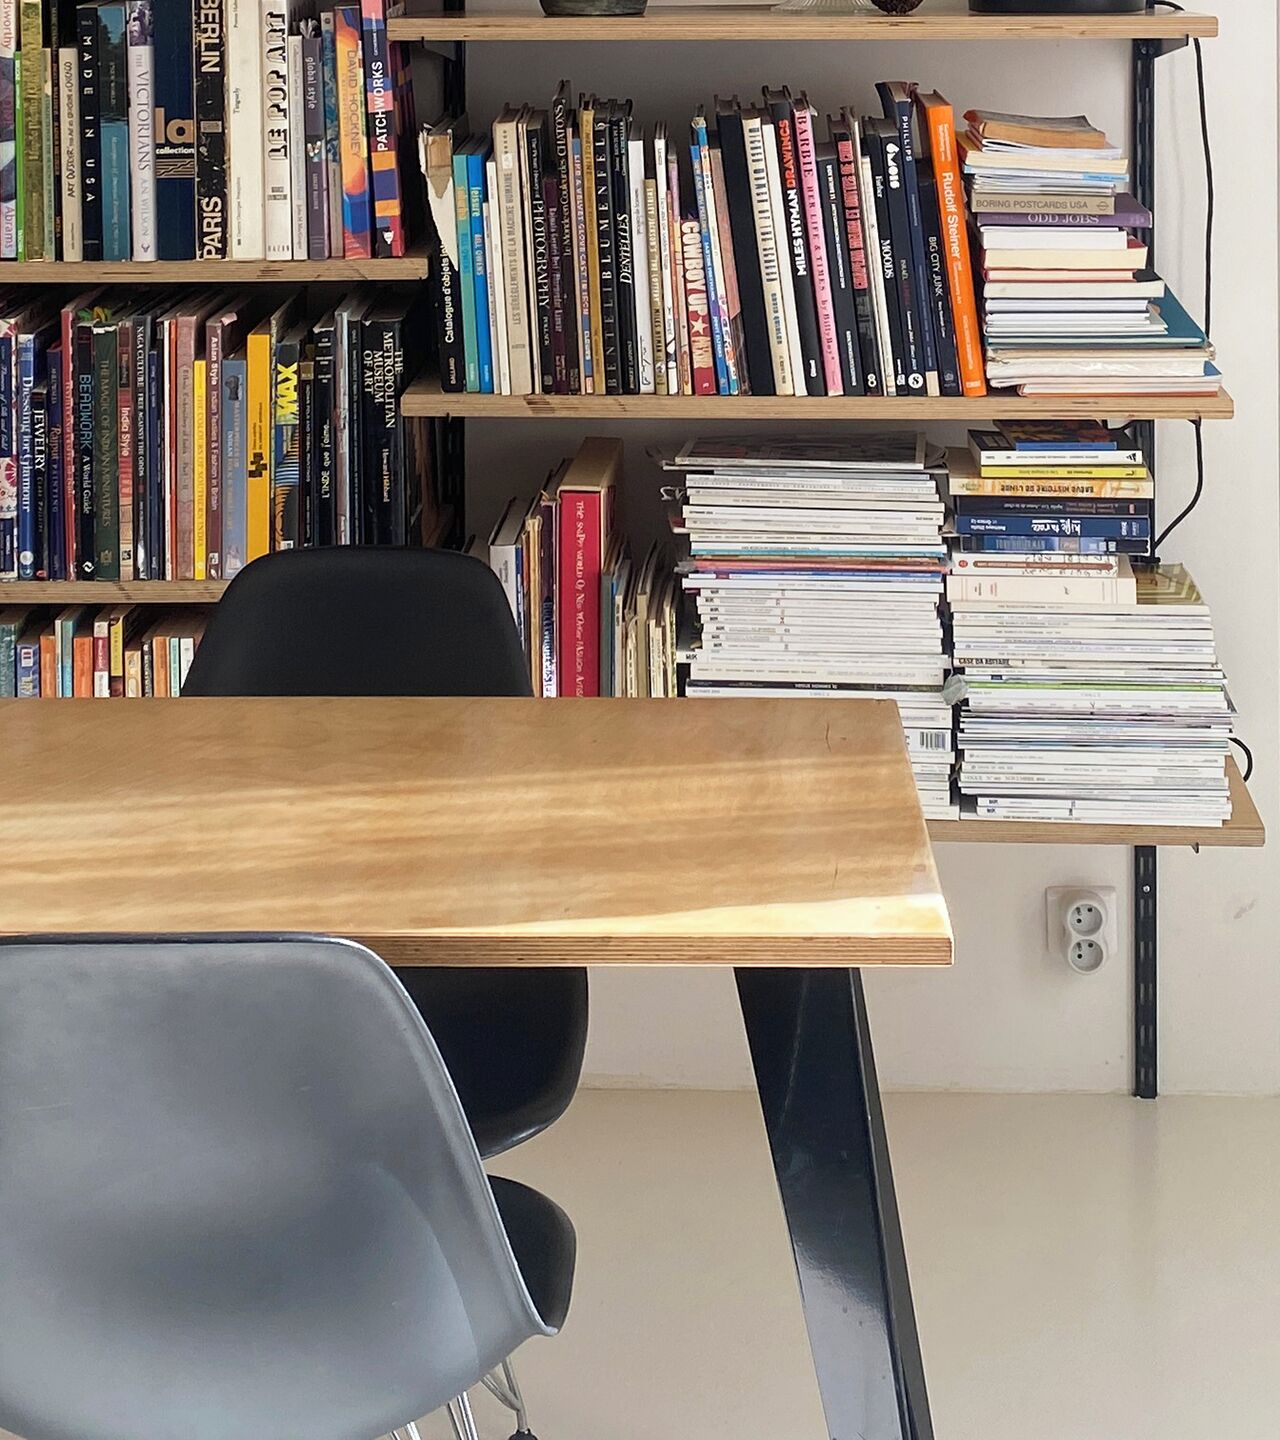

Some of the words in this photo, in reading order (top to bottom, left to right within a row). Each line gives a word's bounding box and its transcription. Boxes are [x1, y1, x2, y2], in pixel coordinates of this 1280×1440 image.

[268, 12, 286, 64] ART
[346, 50, 357, 88] DAVID
[268, 70, 287, 122] POP
[372, 61, 388, 151] PATCHWORKS
[136, 70, 150, 170] VICTORIANS
[156, 108, 194, 144] la
[348, 92, 360, 160] HOCKNEY
[156, 146, 194, 154] collection
[268, 127, 288, 160] LE
[779, 120, 796, 188] DRAWINGS
[942, 173, 956, 212] Rudolf
[976, 200, 1010, 208] BORING
[1014, 200, 1068, 209] POSTCARDS
[1070, 200, 1088, 209] USA
[5, 206, 14, 248] Abrams
[202, 196, 222, 259] PARIS
[788, 190, 802, 238] HYMAN
[1028, 214, 1058, 223] ODD
[1062, 214, 1099, 224] JOBS
[618, 214, 632, 283] DENTELLES
[682, 222, 703, 283] COWBOY
[793, 239, 806, 276] MILES
[947, 216, 960, 258] Steiner
[881, 240, 894, 278] MOODS
[689, 285, 706, 318] UP
[364, 350, 372, 366] OF
[374, 352, 384, 402] MUSEUM
[395, 350, 403, 374] THE
[364, 370, 373, 392] ART
[384, 332, 396, 428] METROPOLITAN
[80, 374, 92, 449] BEADWORK
[34, 410, 44, 471] JEWELRY
